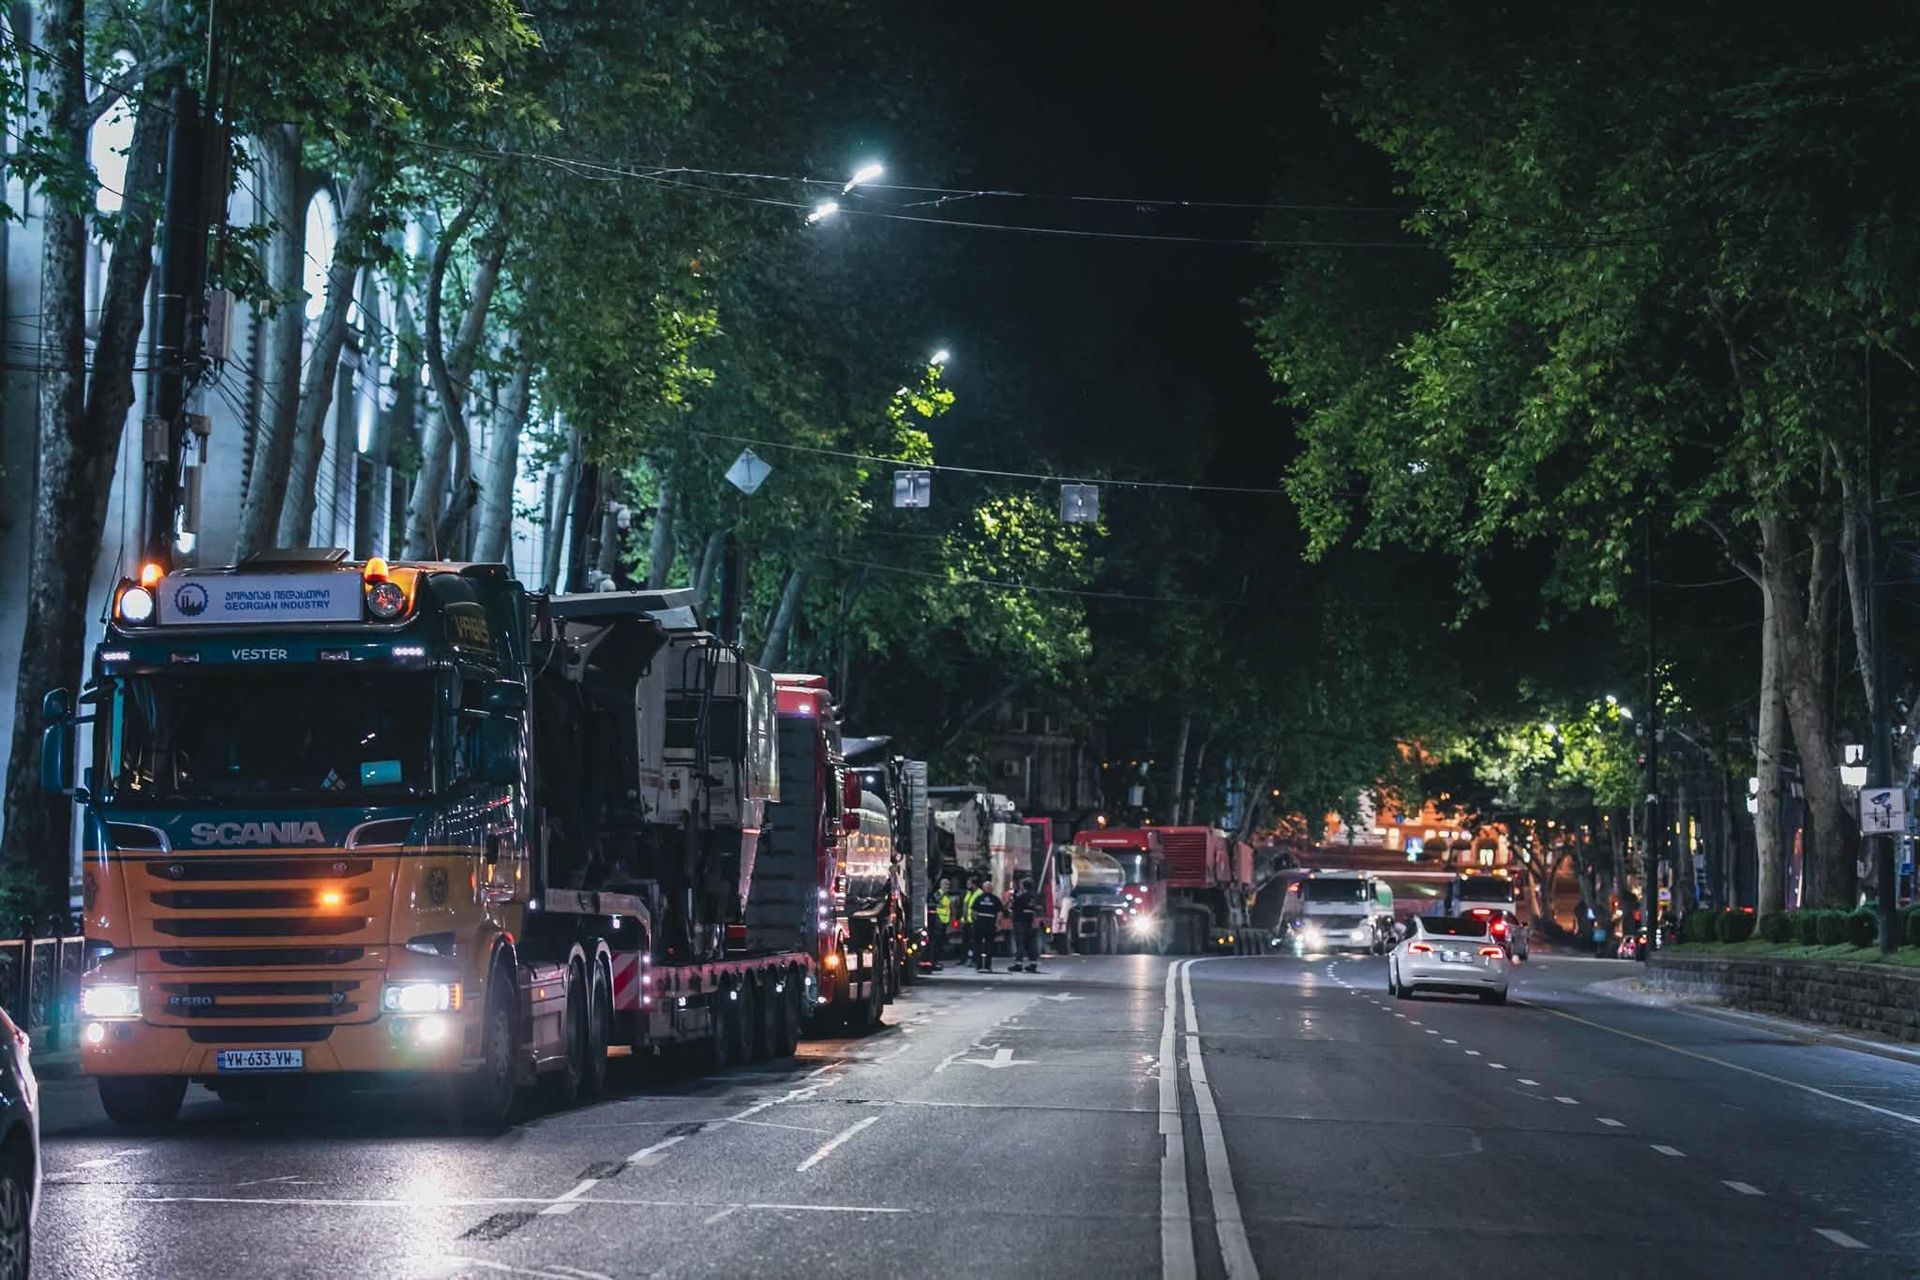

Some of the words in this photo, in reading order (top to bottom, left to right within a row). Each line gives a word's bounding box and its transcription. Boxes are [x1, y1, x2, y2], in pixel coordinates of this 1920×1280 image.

[224, 601, 278, 611] GEORGIAN
[280, 600, 330, 610] INDUSTRY
[231, 648, 288, 660] VESTER
[191, 821, 325, 846] SCANIA
